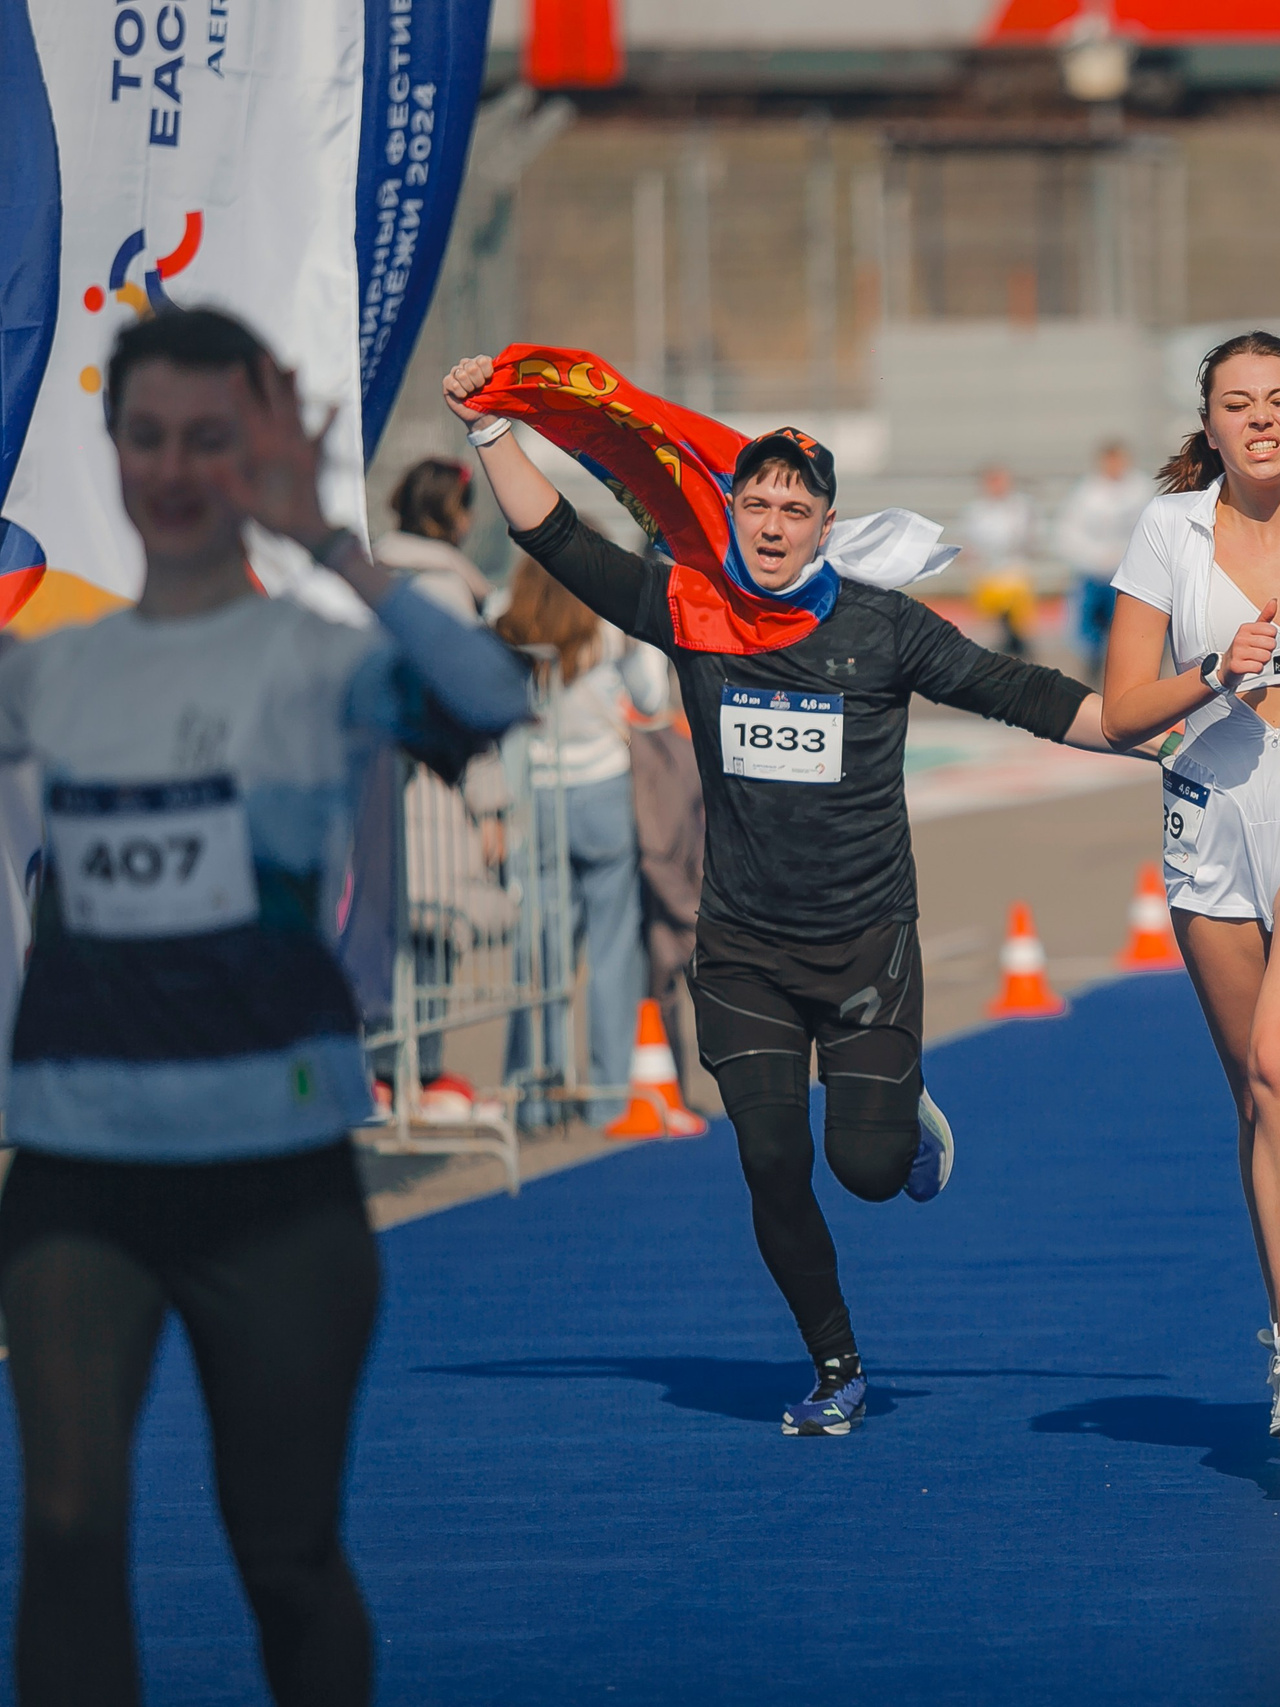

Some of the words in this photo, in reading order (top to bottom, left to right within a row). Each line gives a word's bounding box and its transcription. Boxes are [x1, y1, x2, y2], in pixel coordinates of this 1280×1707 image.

[111, 0, 146, 101] TO
[149, 0, 185, 147] EAC
[404, 82, 437, 187] 2024
[732, 692, 748, 705] 4,6
[800, 698, 817, 710] 4,6
[734, 723, 826, 754] 1833
[1178, 783, 1191, 796] 4,6
[81, 832, 206, 887] 407
